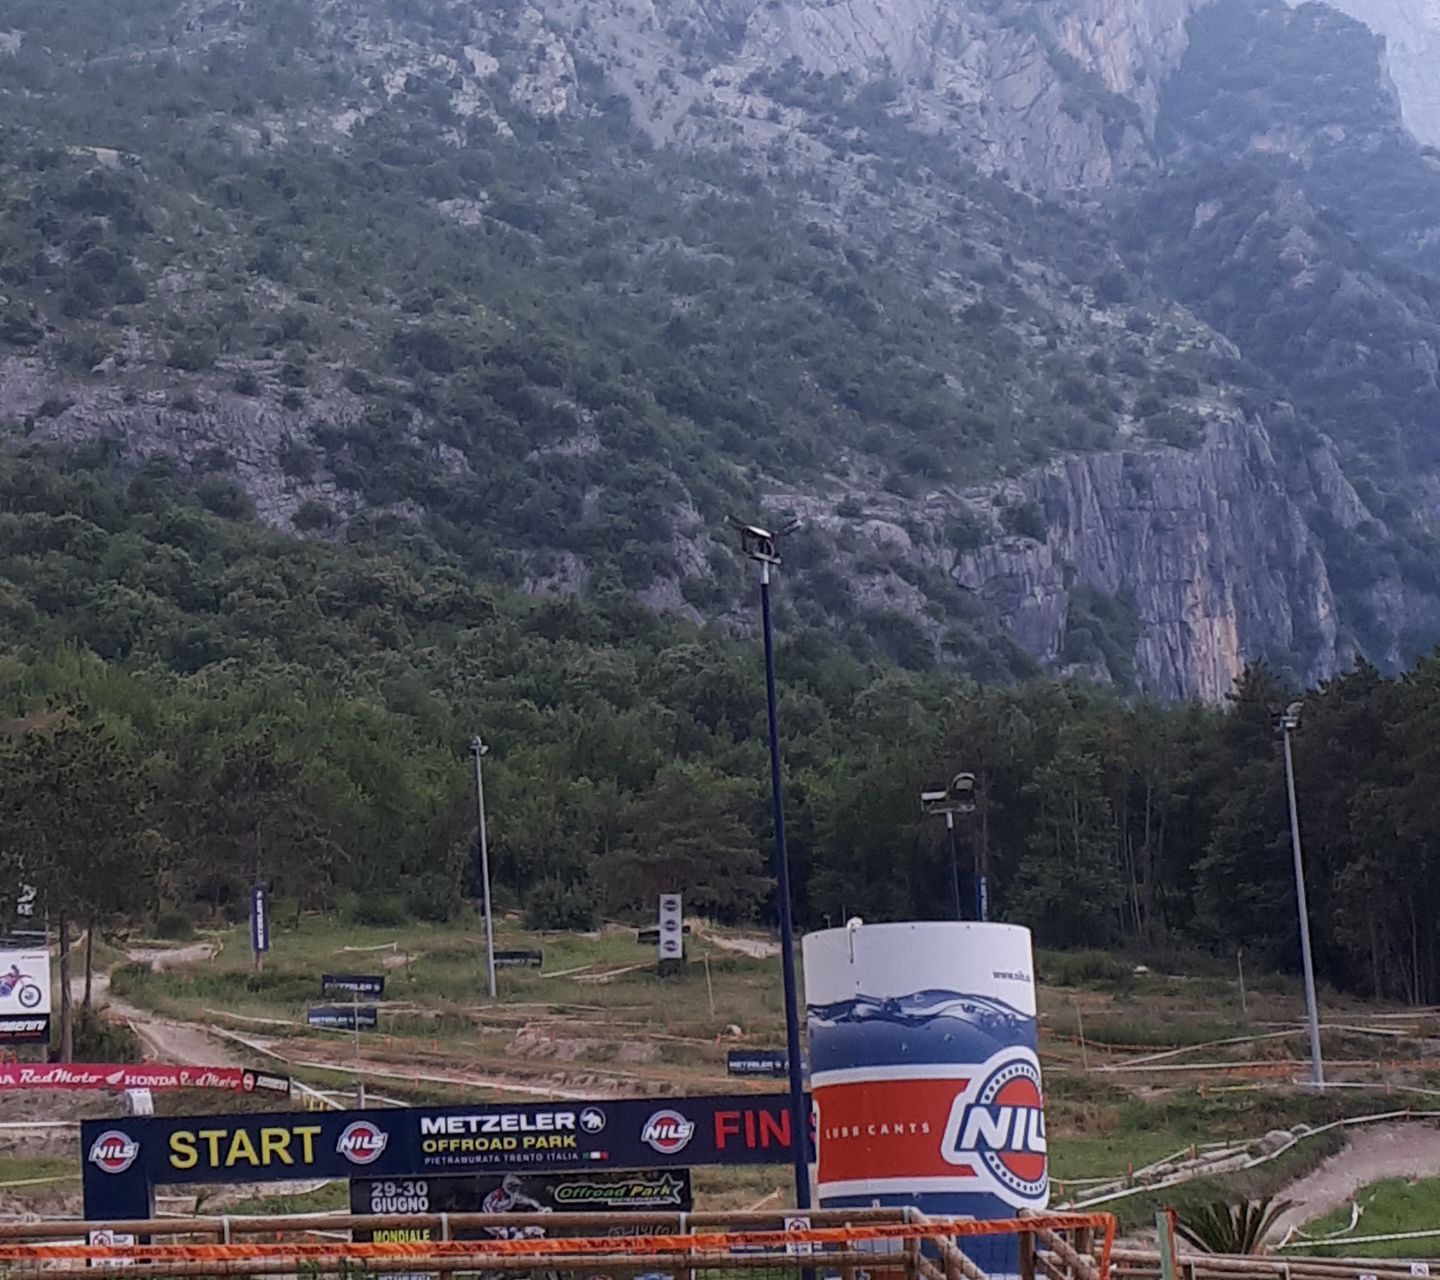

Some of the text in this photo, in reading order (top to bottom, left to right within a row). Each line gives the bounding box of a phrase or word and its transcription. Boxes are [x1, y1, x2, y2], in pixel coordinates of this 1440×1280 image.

[20, 1069, 102, 1085] RedMoto
[125, 1074, 177, 1087] HONDA
[421, 1112, 575, 1135] METZELER
[643, 1122, 694, 1141] NILS
[714, 1109, 816, 1150] FIN
[826, 1122, 930, 1140] LUBRCANTS
[959, 1105, 1047, 1154] NIL
[169, 1125, 322, 1169] START
[339, 1133, 387, 1151] NILS
[422, 1134, 576, 1153] OFFROAD PARK
[92, 1143, 139, 1159] NILS
[424, 1151, 579, 1166] PIETRAMURATA TRENTO ITALIA
[371, 1181, 428, 1197] 29-30
[560, 1183, 671, 1199] Offroad Park
[371, 1196, 428, 1213] GIUGNO
[373, 1228, 430, 1243] MONDIALE
